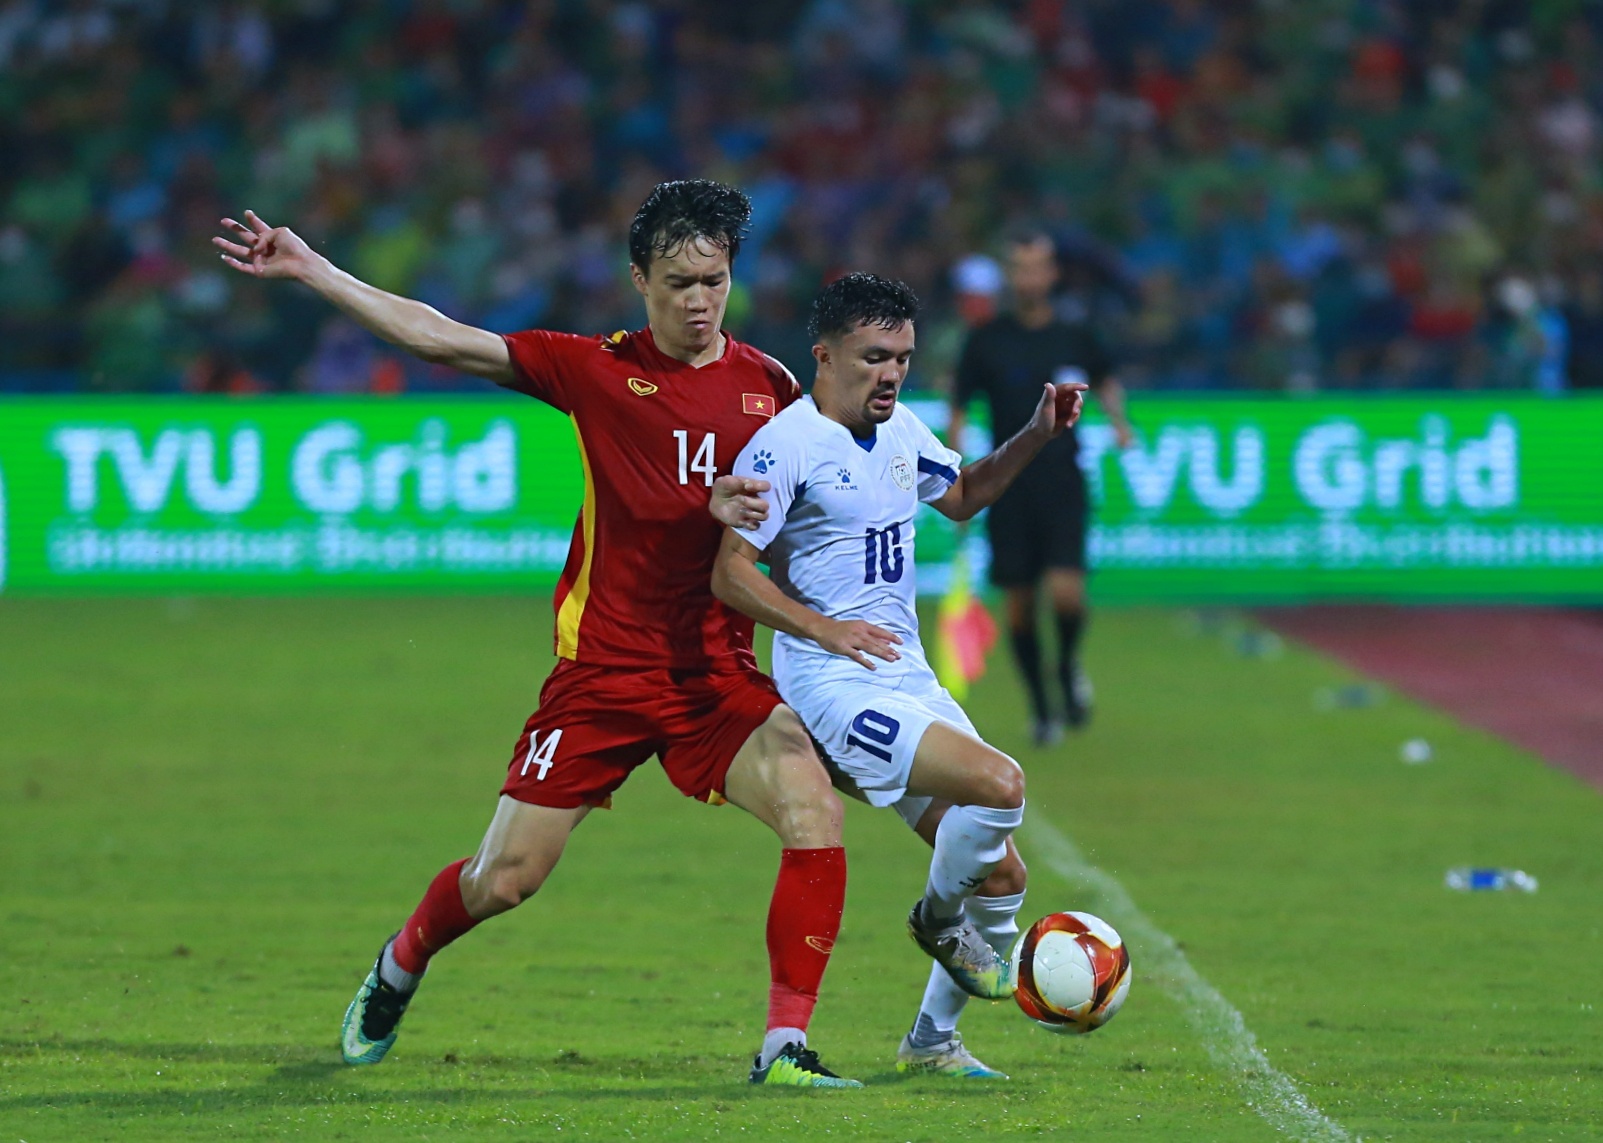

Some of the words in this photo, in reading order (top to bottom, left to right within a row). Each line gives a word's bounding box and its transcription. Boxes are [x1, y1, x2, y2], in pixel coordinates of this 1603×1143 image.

[52, 424, 262, 513] TVU
[293, 419, 517, 512] Grid
[673, 430, 717, 486] 14
[1295, 413, 1519, 511] Grid
[864, 522, 905, 584] 10
[520, 728, 563, 780] 14
[847, 708, 900, 763] 10
